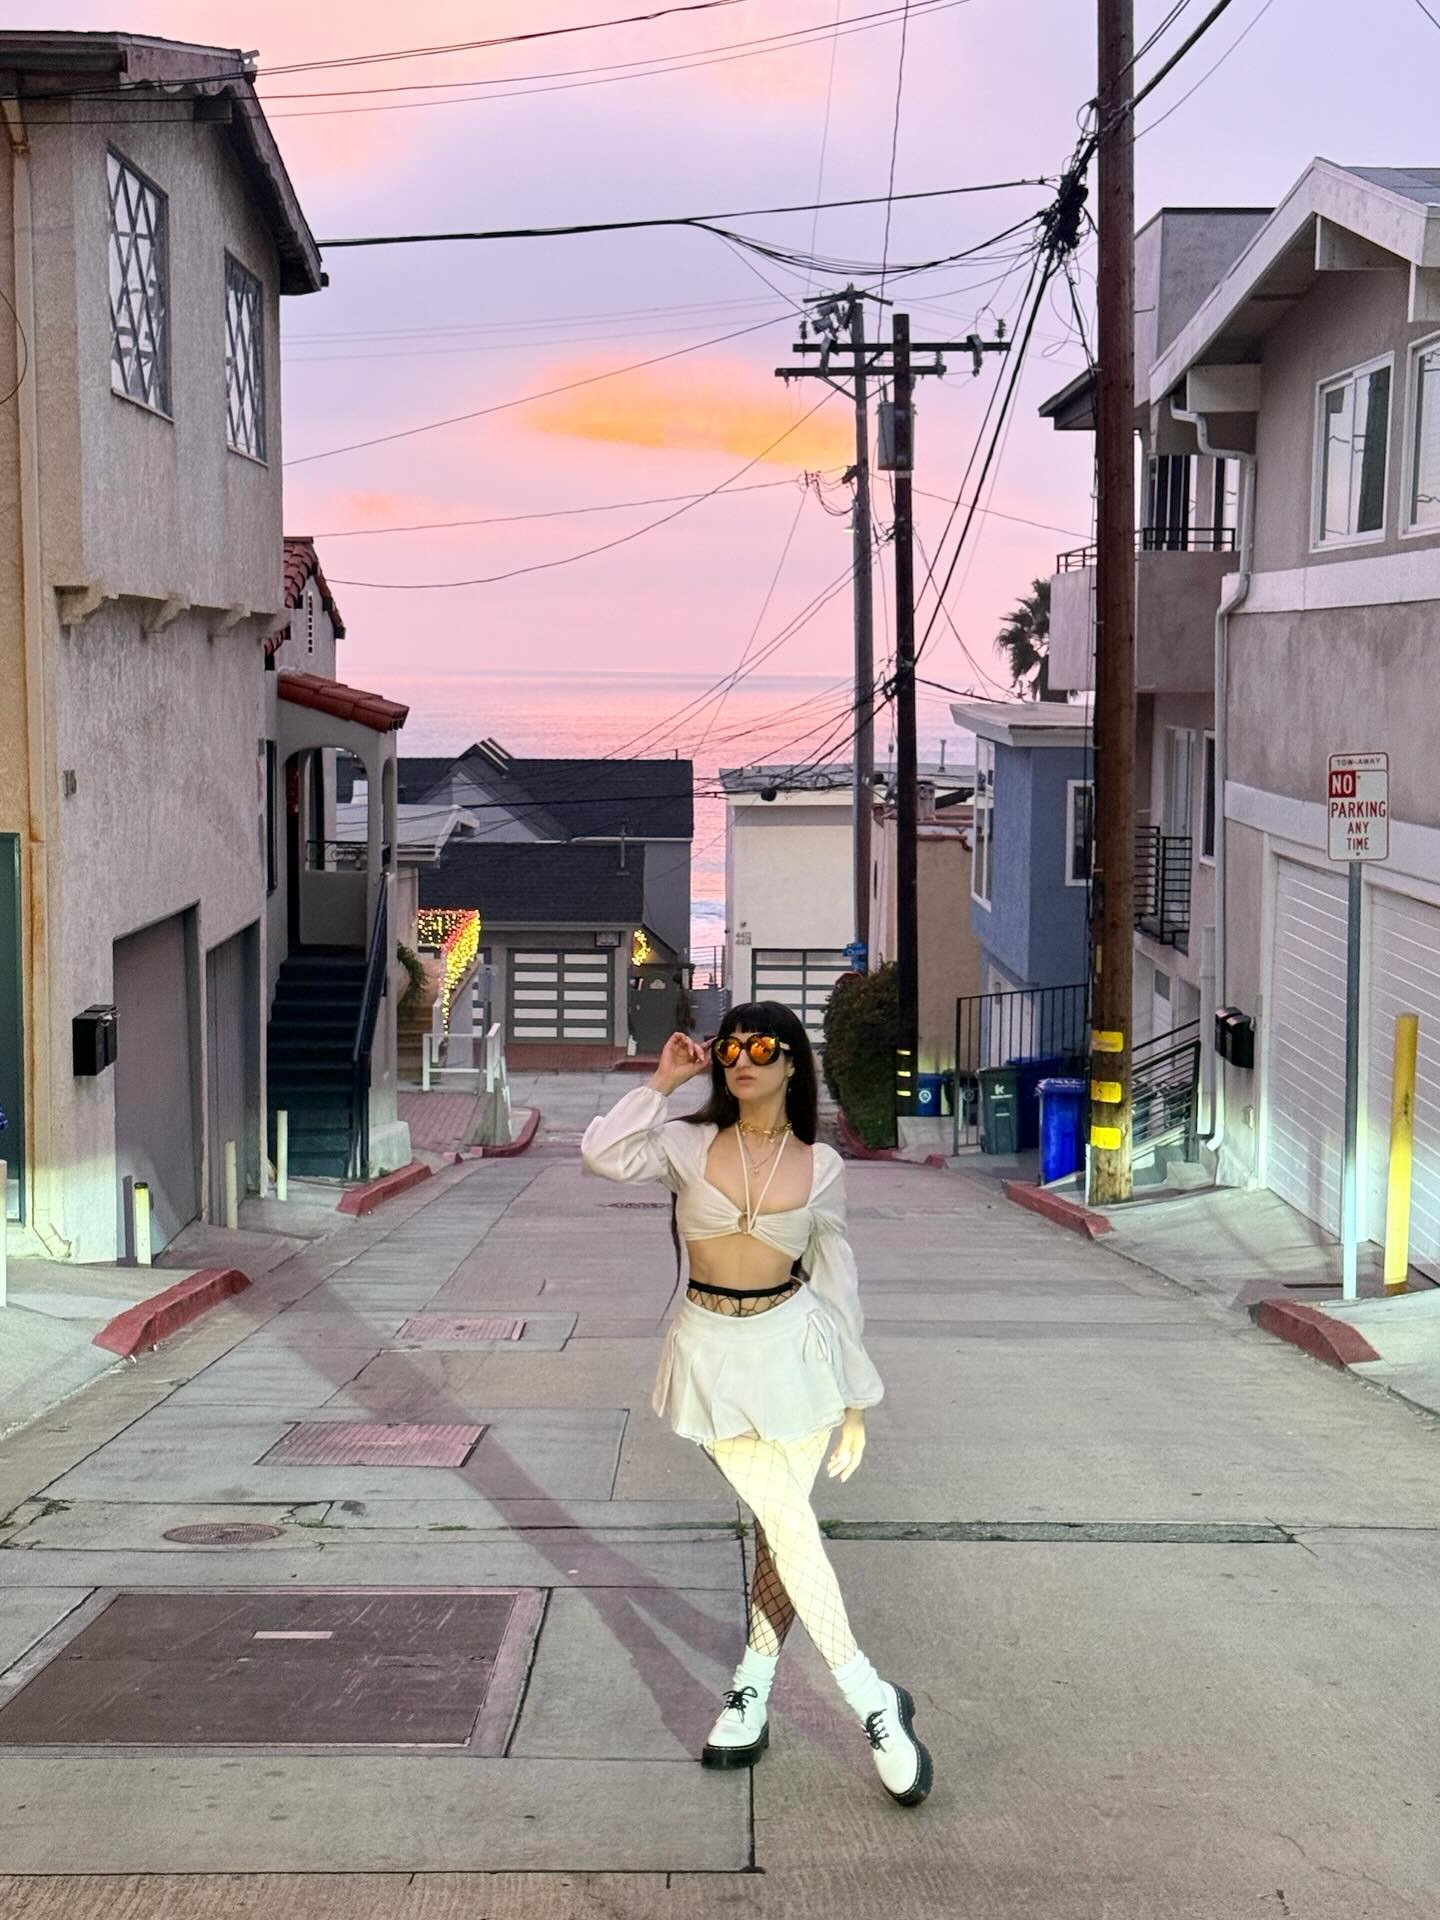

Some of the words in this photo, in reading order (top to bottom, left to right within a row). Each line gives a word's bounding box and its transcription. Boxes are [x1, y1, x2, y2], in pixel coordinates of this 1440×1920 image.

[1331, 774, 1353, 795] NO
[1330, 801, 1386, 819] PARKING
[1347, 821, 1369, 834] ANY
[1346, 838, 1369, 850] TIME
